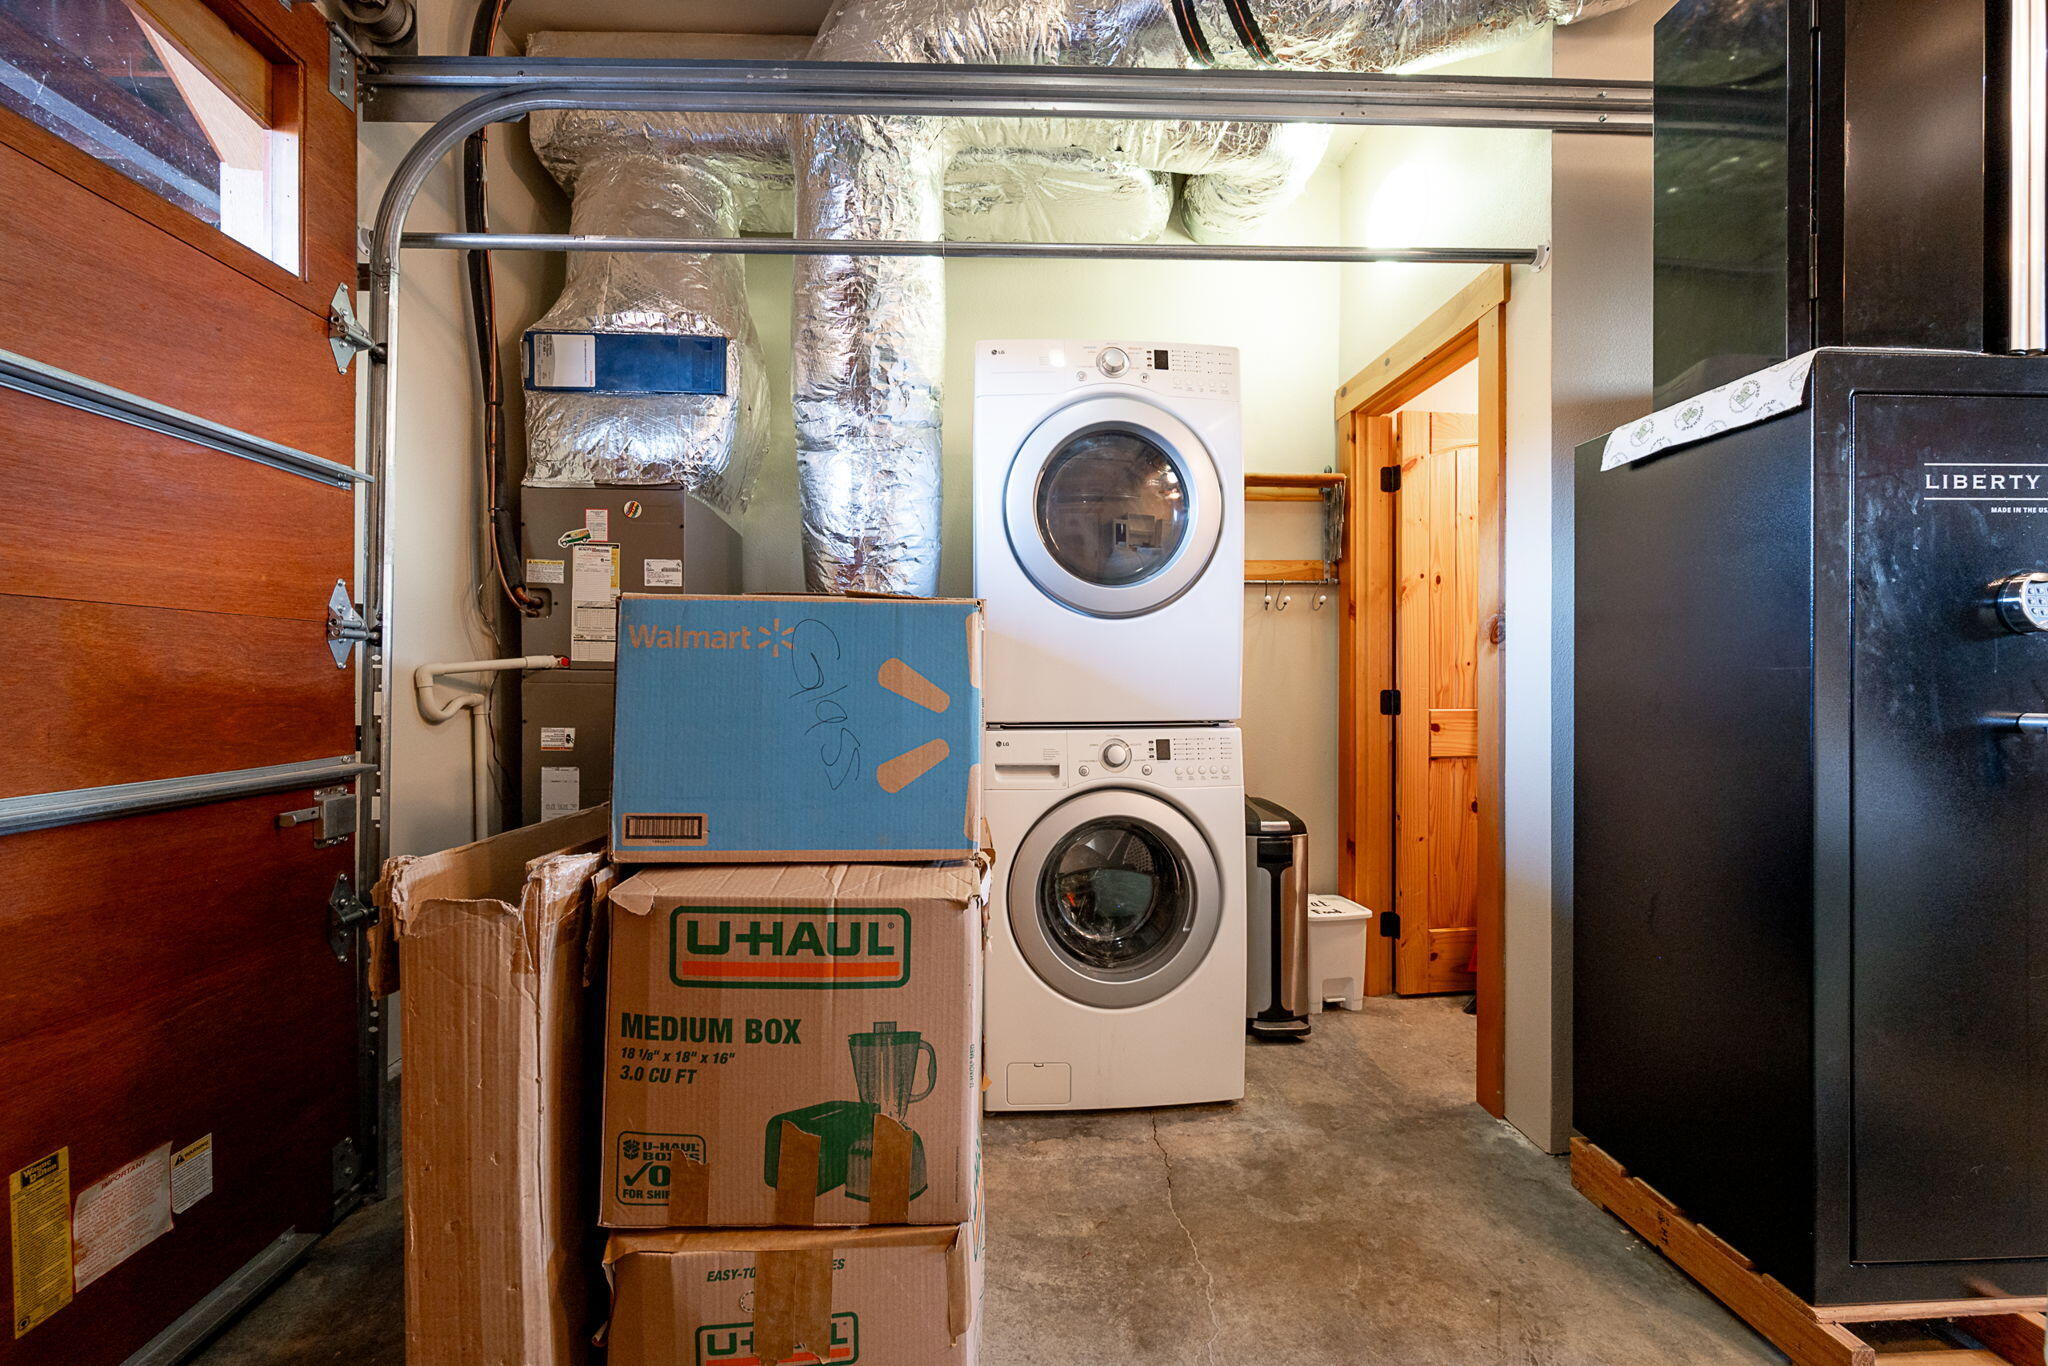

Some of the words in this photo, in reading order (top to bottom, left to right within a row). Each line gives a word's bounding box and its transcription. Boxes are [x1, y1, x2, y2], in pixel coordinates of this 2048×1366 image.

[1925, 474, 2041, 490] LIBERTY
[627, 624, 752, 650] Walmart
[620, 1012, 733, 1044] MEDIUM
[745, 1018, 802, 1045] BOX
[621, 1047, 635, 1059] 18
[619, 1065, 645, 1082] 3.0
[648, 1067, 672, 1083] CU
[675, 1069, 698, 1084] FT
[23, 1158, 53, 1179] Wayne
[101, 1159, 147, 1190] IMPORTANT
[623, 1189, 643, 1199] FOR
